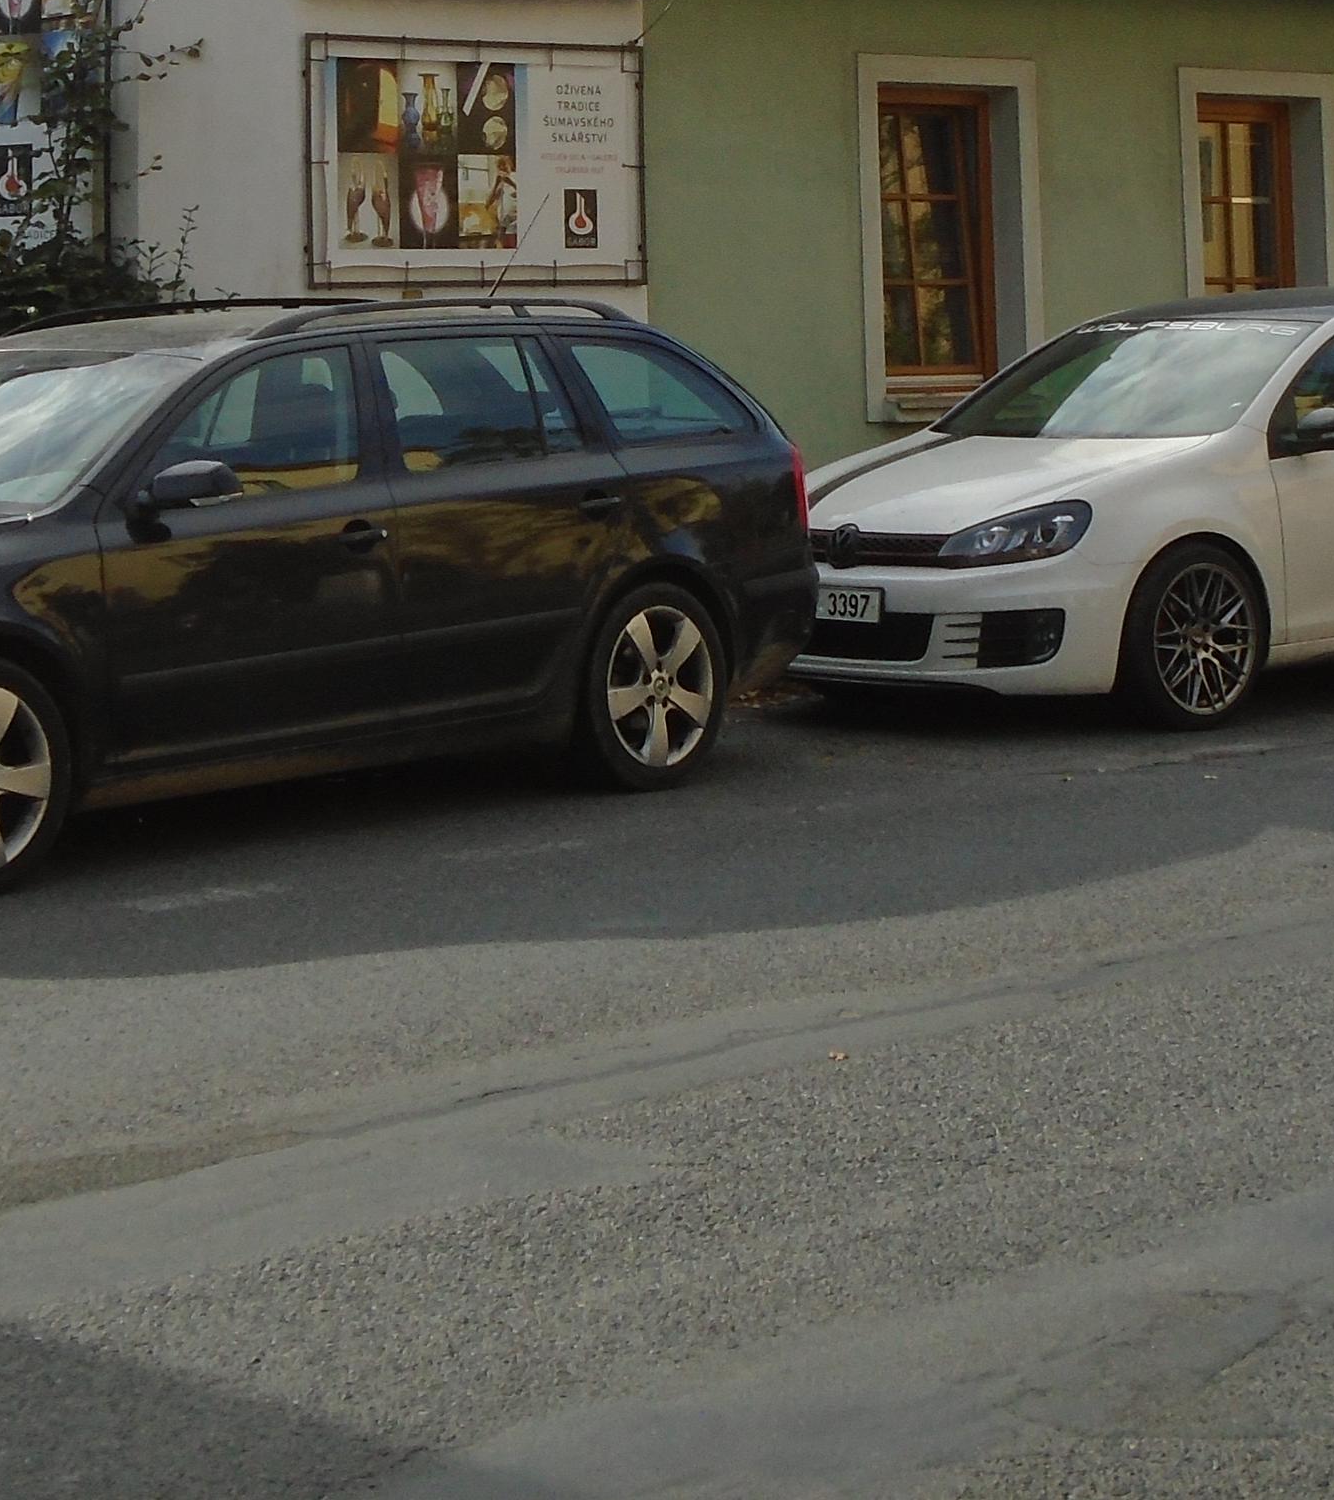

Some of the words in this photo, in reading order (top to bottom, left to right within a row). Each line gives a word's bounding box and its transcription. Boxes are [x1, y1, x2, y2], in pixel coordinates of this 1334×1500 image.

[557, 100, 600, 112] TRADICE
[1076, 320, 1303, 337] WOLFSBURG
[827, 592, 871, 619] 3397
